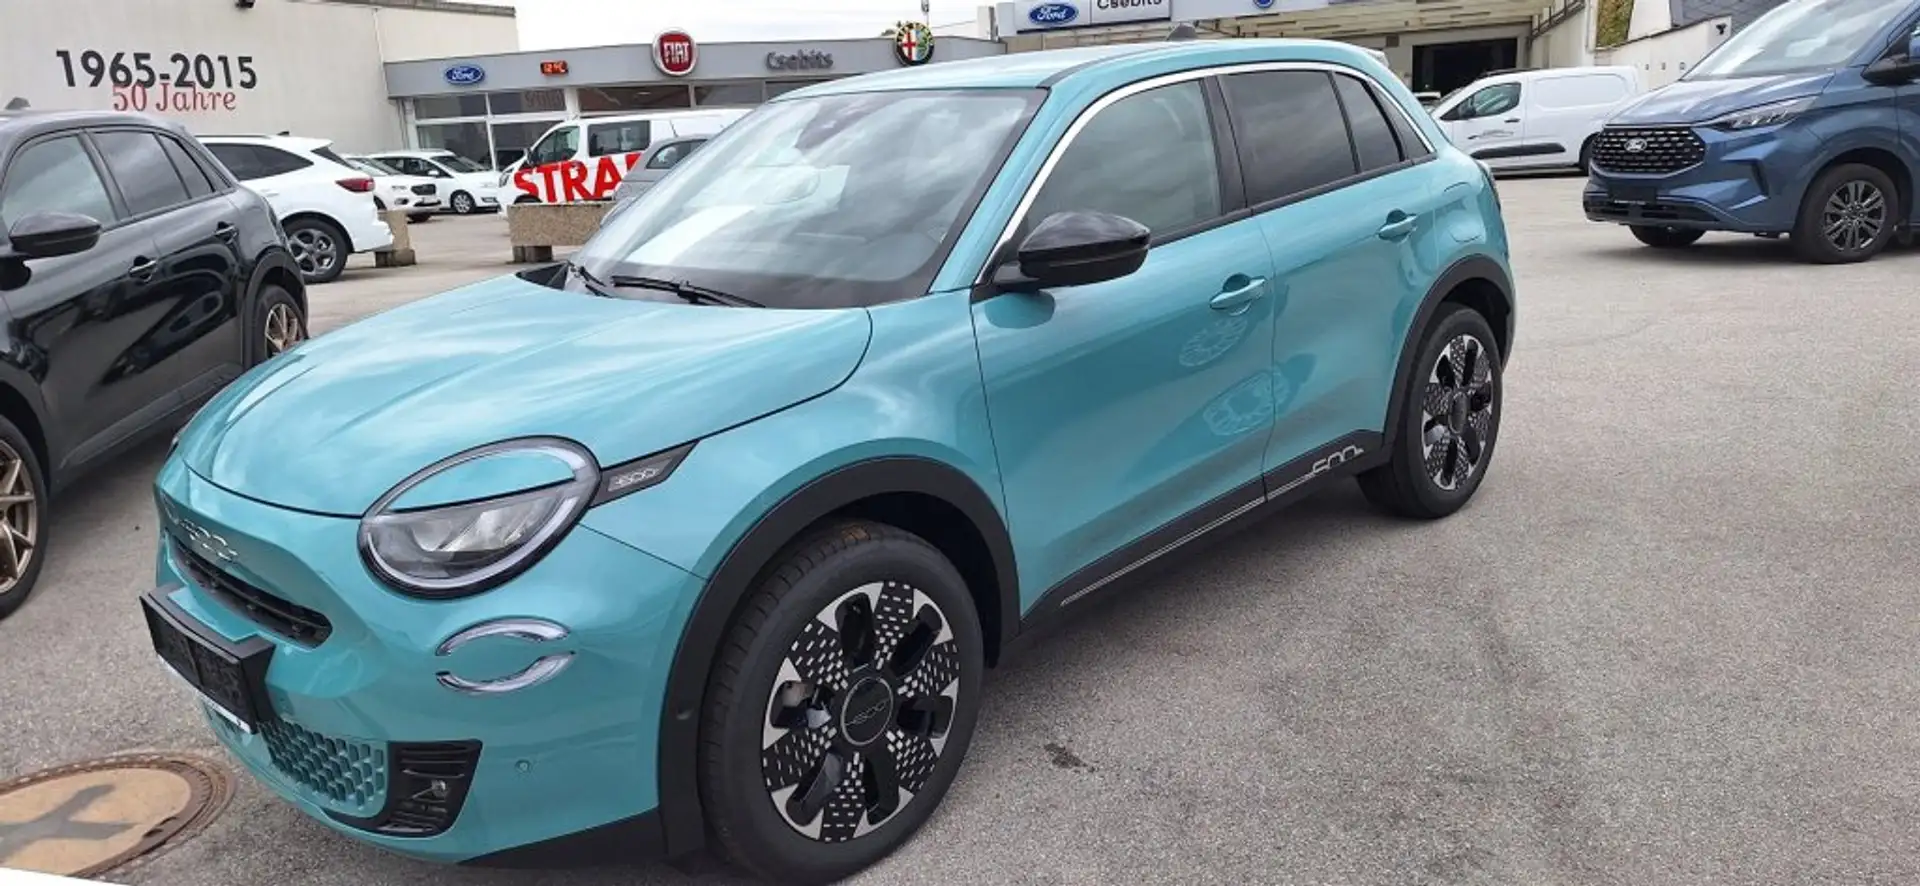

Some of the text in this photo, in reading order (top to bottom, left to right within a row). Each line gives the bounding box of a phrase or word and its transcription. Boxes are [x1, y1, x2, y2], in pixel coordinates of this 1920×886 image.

[1036, 4, 1068, 21] Ford
[663, 41, 690, 64] FIAT
[766, 48, 834, 70] Csebits
[56, 49, 257, 89] 1965-2015
[113, 81, 236, 112] 50 Jahre
